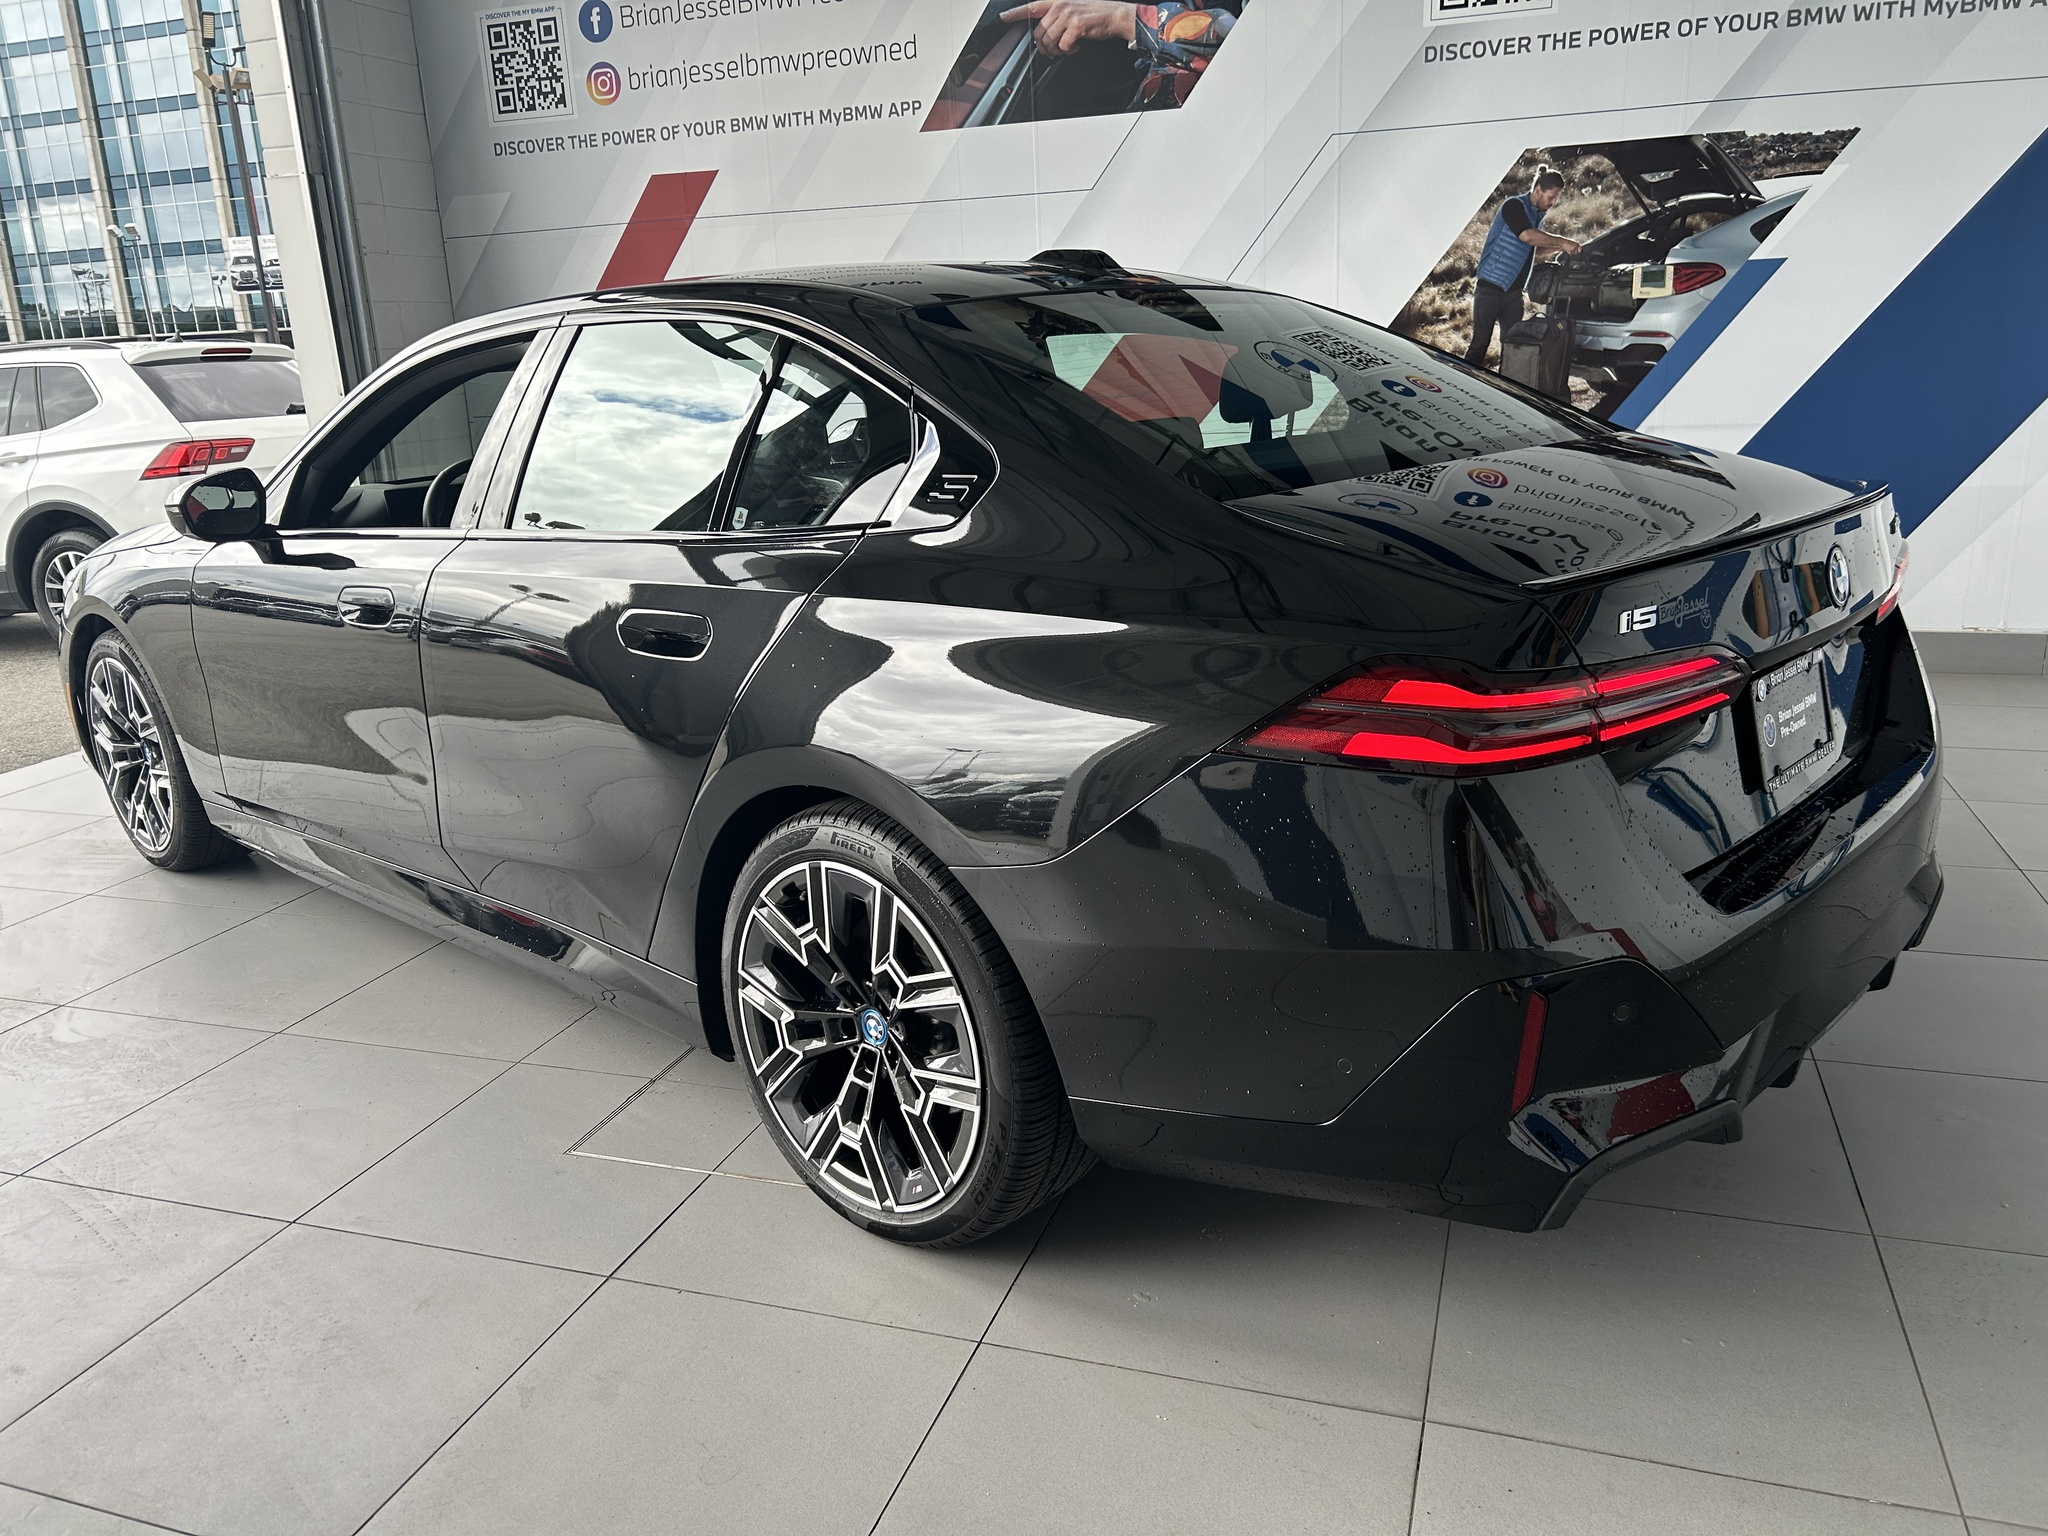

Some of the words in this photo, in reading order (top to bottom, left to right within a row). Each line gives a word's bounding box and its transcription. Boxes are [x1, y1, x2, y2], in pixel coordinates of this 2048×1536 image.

[485, 12, 511, 20] DISCOVER
[620, 0, 844, 28] BrianJesselB
[1424, 35, 1532, 63] DISCOVER
[1537, 31, 1582, 51] THE
[1588, 21, 1671, 47] POWER
[1677, 17, 1709, 37] OF
[1713, 11, 1779, 34] YOUR
[1786, 4, 1847, 27] BMW
[1853, 0, 1915, 22] WITH
[627, 34, 918, 91] brianjesselbmwpreowned
[493, 136, 565, 157] DISCOVER
[568, 133, 598, 149] THE
[602, 127, 657, 147] POWER
[660, 124, 680, 141] OF
[683, 120, 727, 138] YOUR
[730, 115, 769, 133] BMW
[772, 110, 815, 128] WITH
[819, 103, 883, 127] MyBMW
[888, 100, 923, 118] APP
[1619, 604, 1657, 635] i5
[1770, 671, 1784, 686] Brian
[1783, 662, 1797, 681] Jessel
[1796, 656, 1809, 673] BMW
[1778, 708, 1792, 723] Brian
[1792, 698, 1805, 717] Jessel
[1805, 691, 1817, 708] BMW
[1780, 714, 1806, 738] Pre-Owned
[1768, 778, 1780, 792] THE
[1780, 761, 1805, 785] ULTIMATE
[1817, 741, 1835, 760] DEALER
[830, 831, 876, 860] PIRELLI
